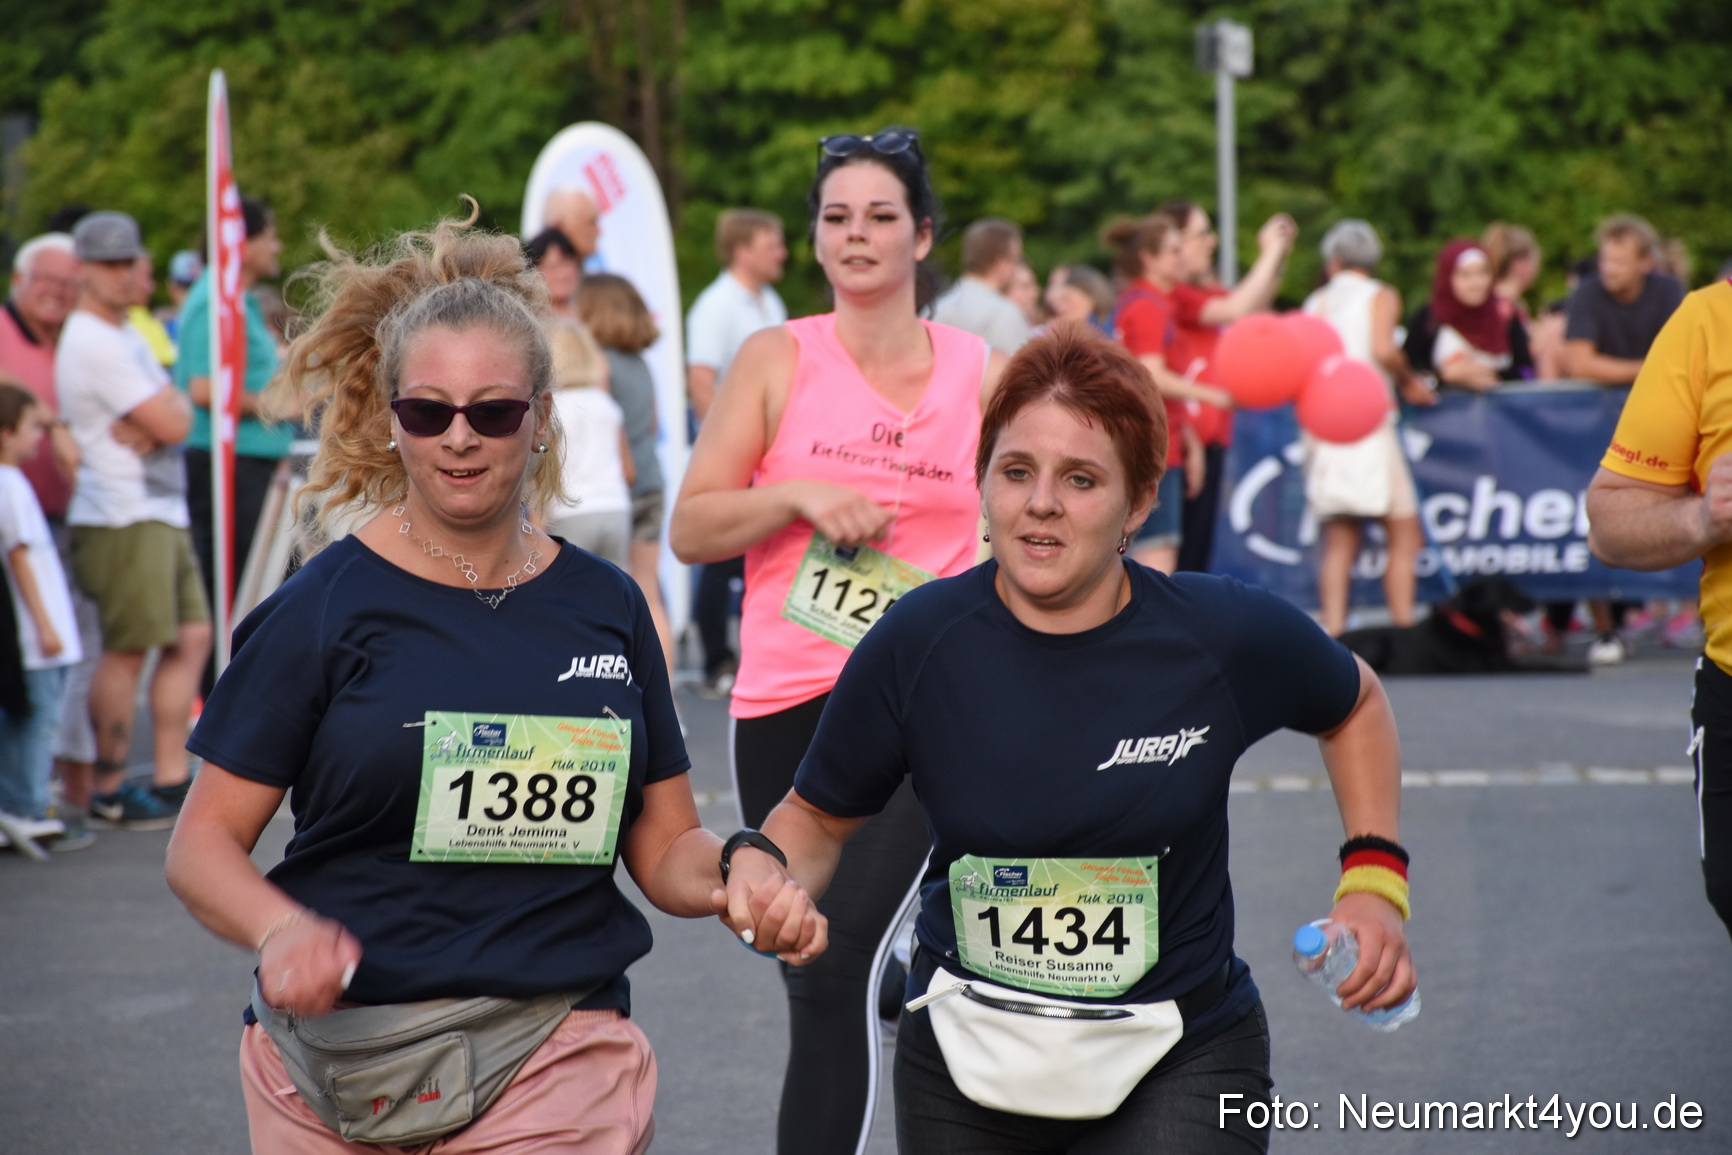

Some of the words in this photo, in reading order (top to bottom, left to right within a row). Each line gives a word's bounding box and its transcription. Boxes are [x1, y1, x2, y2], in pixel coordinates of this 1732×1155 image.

[871, 423, 904, 448] Die
[557, 654, 628, 682] JURA
[456, 743, 536, 760] firmenlauf
[1097, 734, 1179, 771] JURA
[580, 760, 616, 772] 2019
[449, 770, 597, 823] 1388
[466, 825, 504, 837] Denk
[509, 826, 567, 838] Jemima
[449, 838, 507, 848] Lebenshilfe
[510, 839, 558, 849] Neumarkt
[573, 841, 581, 849] V
[980, 883, 1059, 897] firmenlauf
[1107, 893, 1144, 904] 2019
[978, 906, 1130, 956] 1434
[989, 961, 1045, 979] Lebenshilfe
[1048, 972, 1098, 983] Neumarkt
[1113, 974, 1121, 983] V
[995, 950, 1041, 969] Reiser
[1046, 958, 1113, 972] Susanne
